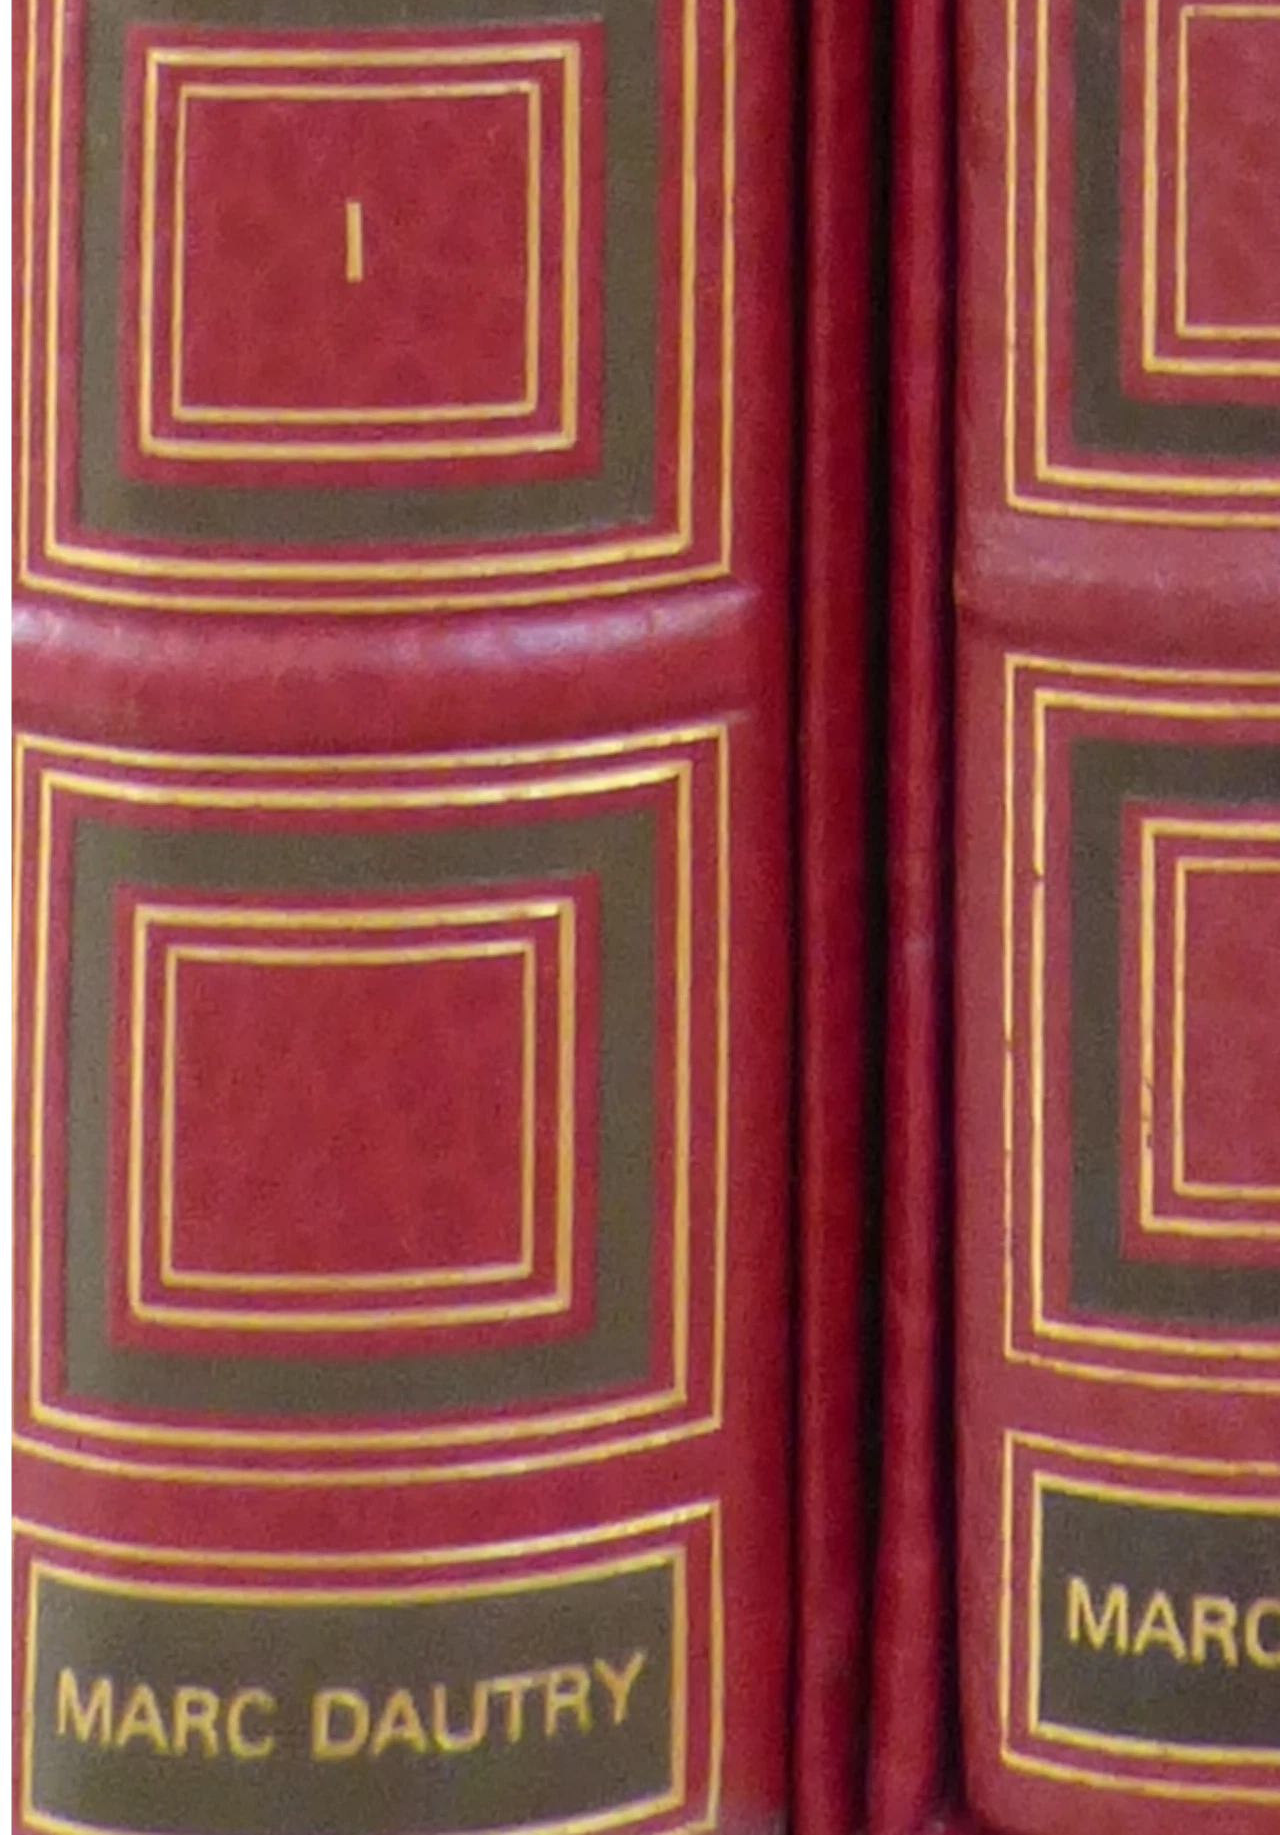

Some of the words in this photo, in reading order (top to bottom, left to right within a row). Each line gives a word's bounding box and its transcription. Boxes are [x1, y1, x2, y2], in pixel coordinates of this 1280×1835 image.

[344, 200, 365, 283] I
[54, 1664, 274, 1759] MARC
[311, 1649, 647, 1760] DAUTRY
